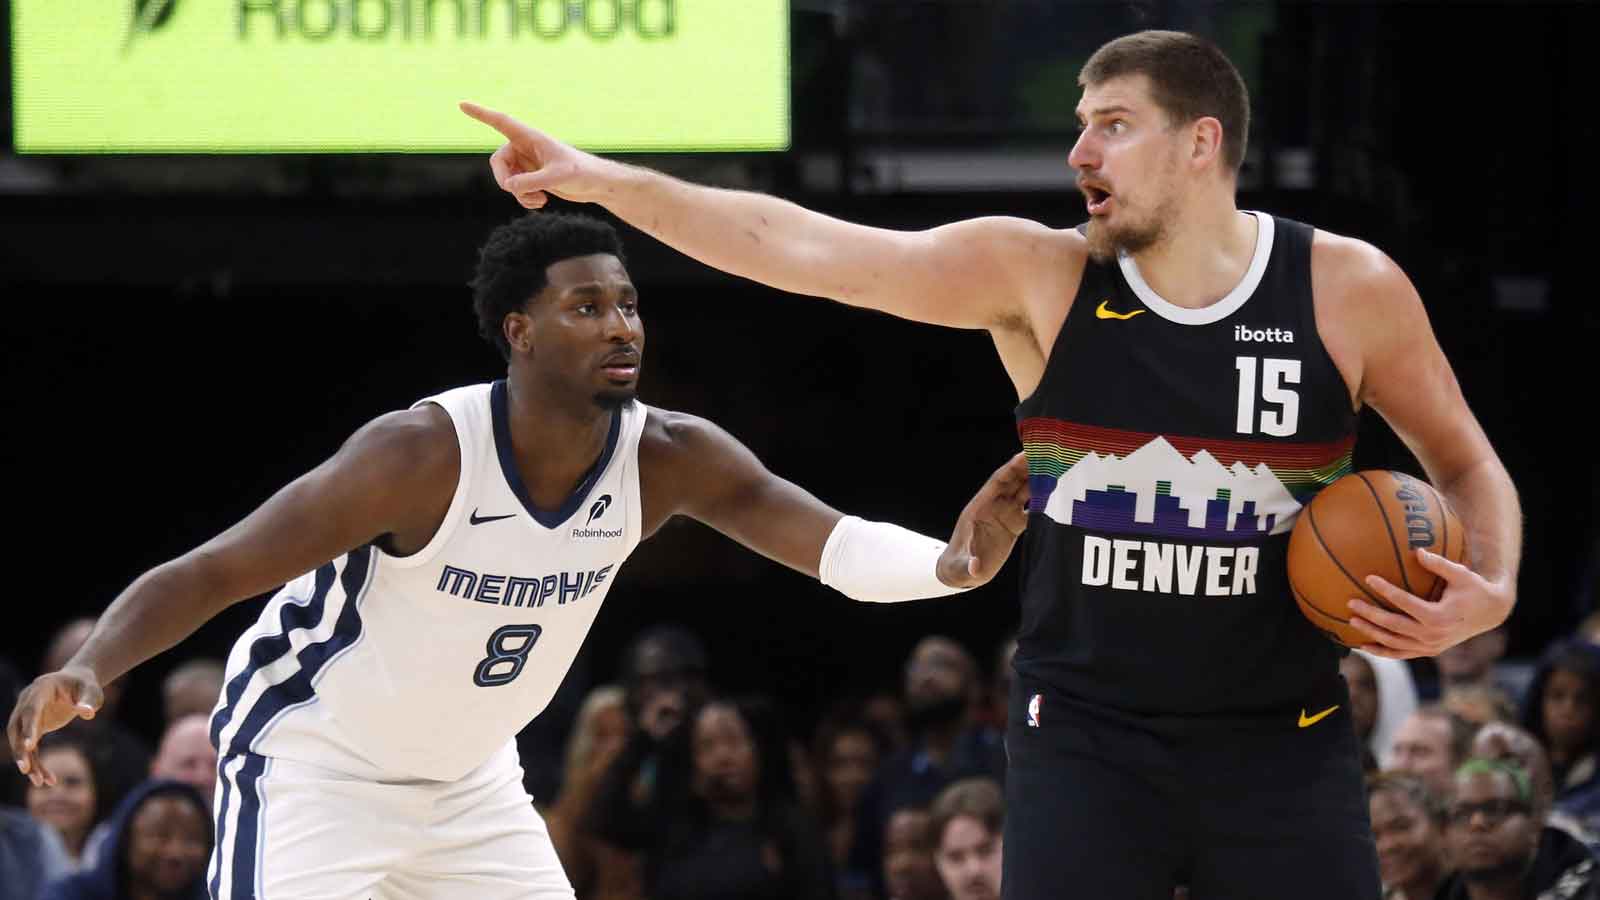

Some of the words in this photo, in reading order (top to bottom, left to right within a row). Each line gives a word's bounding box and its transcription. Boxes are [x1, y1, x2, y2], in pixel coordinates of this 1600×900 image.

[239, 0, 675, 40] Robinhood
[1234, 325, 1294, 343] ibotta
[1235, 356, 1302, 437] 15
[572, 527, 623, 538] Robinhood
[1396, 476, 1435, 549] Wil
[436, 564, 614, 608] MEMPHIS
[1081, 535, 1260, 597] DENVER
[473, 623, 543, 688] 8
